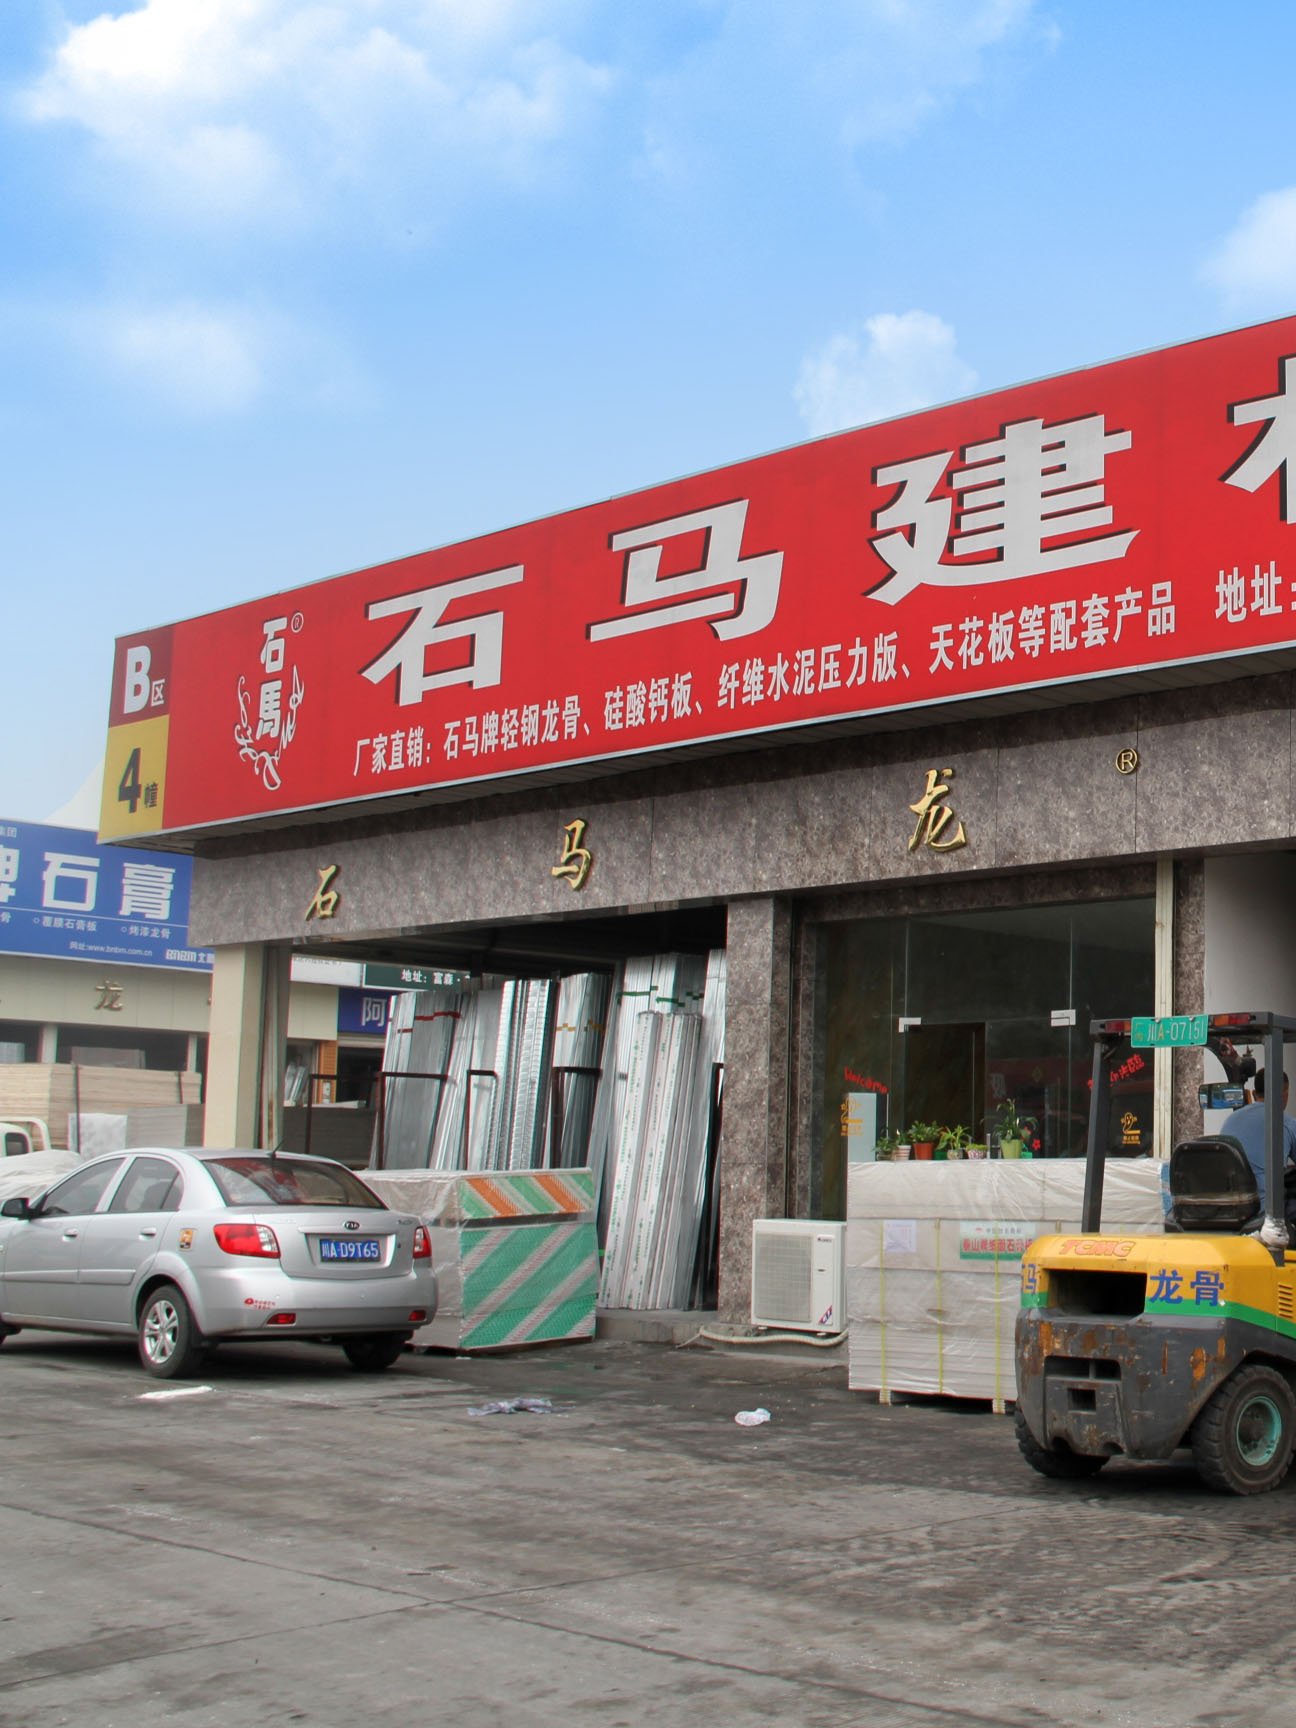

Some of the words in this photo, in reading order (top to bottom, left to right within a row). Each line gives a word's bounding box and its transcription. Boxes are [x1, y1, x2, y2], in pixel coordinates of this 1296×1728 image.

[361, 997, 386, 1027] 阿
[1059, 1239, 1136, 1257] TCMC
[1149, 1269, 1225, 1307] 龙骨
